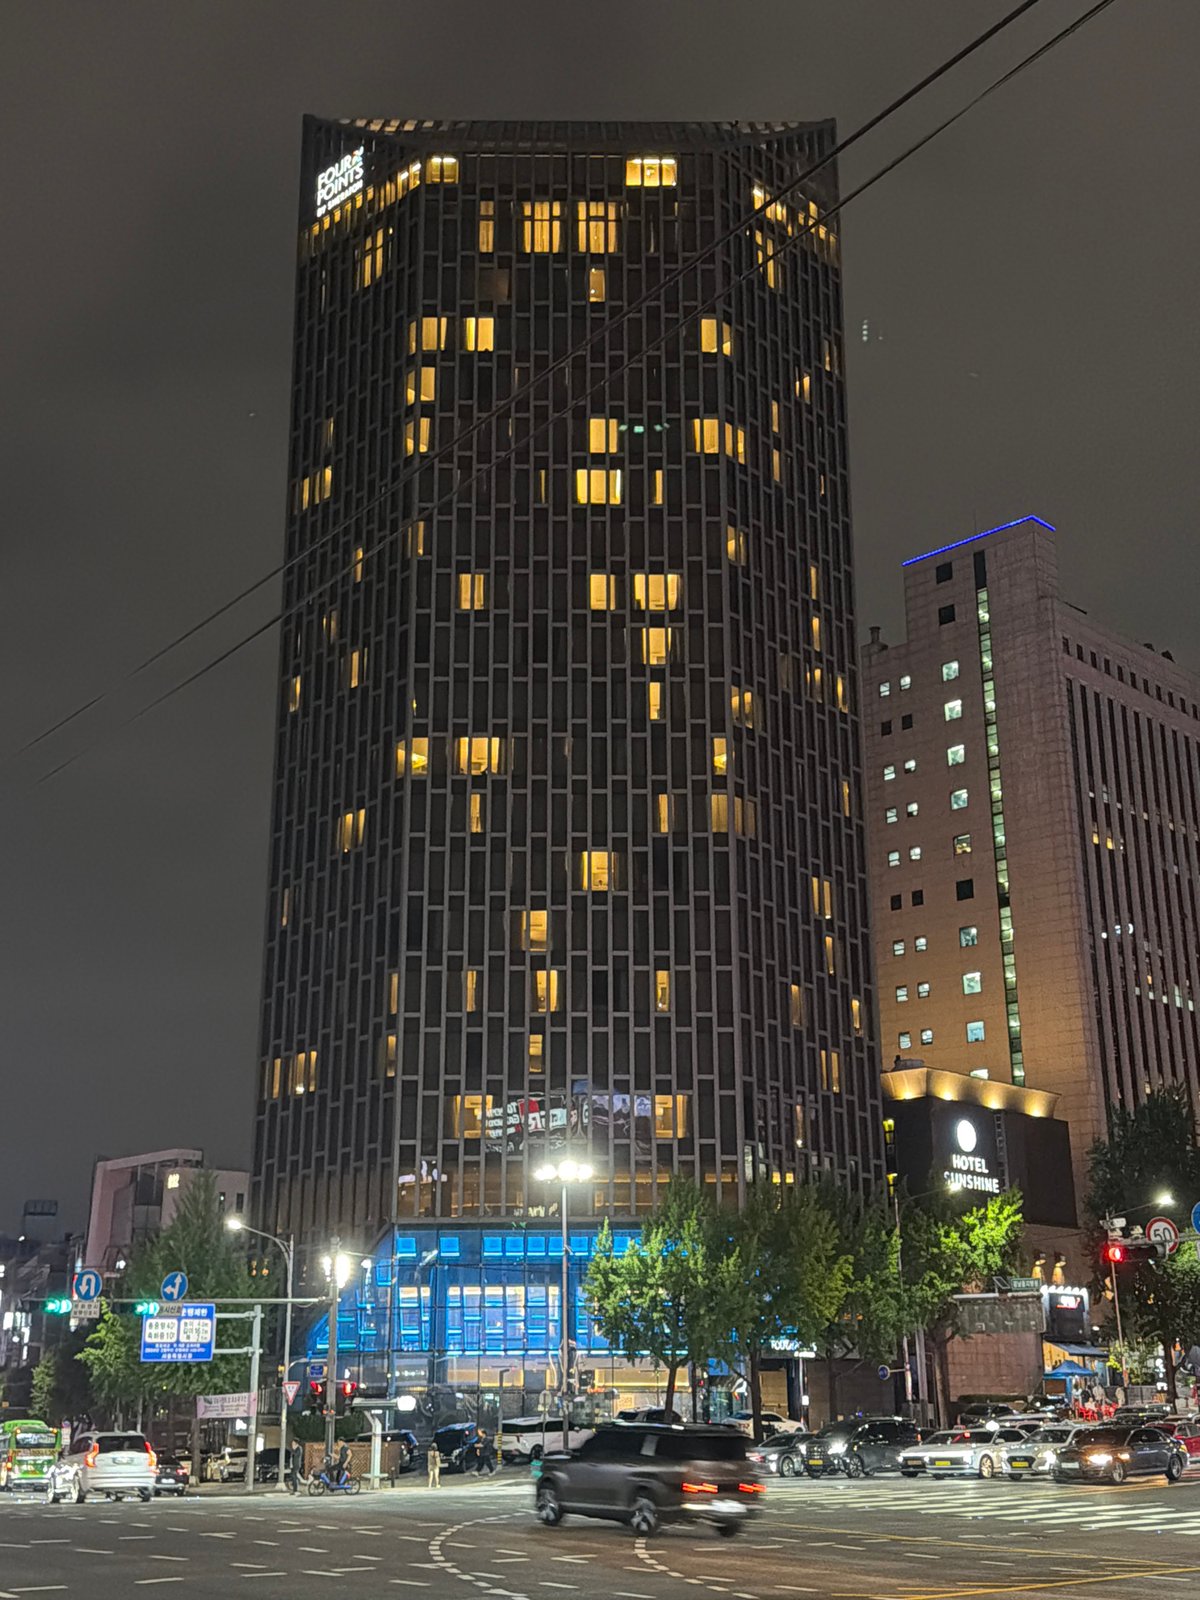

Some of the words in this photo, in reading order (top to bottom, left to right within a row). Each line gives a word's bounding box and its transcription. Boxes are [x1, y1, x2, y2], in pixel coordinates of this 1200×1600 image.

[316, 162, 364, 206] POINTS
[317, 154, 352, 191] FOUR
[952, 1153, 989, 1174] HOTEL
[943, 1170, 1000, 1194] SUNSHINE
[1153, 1227, 1173, 1243] 50
